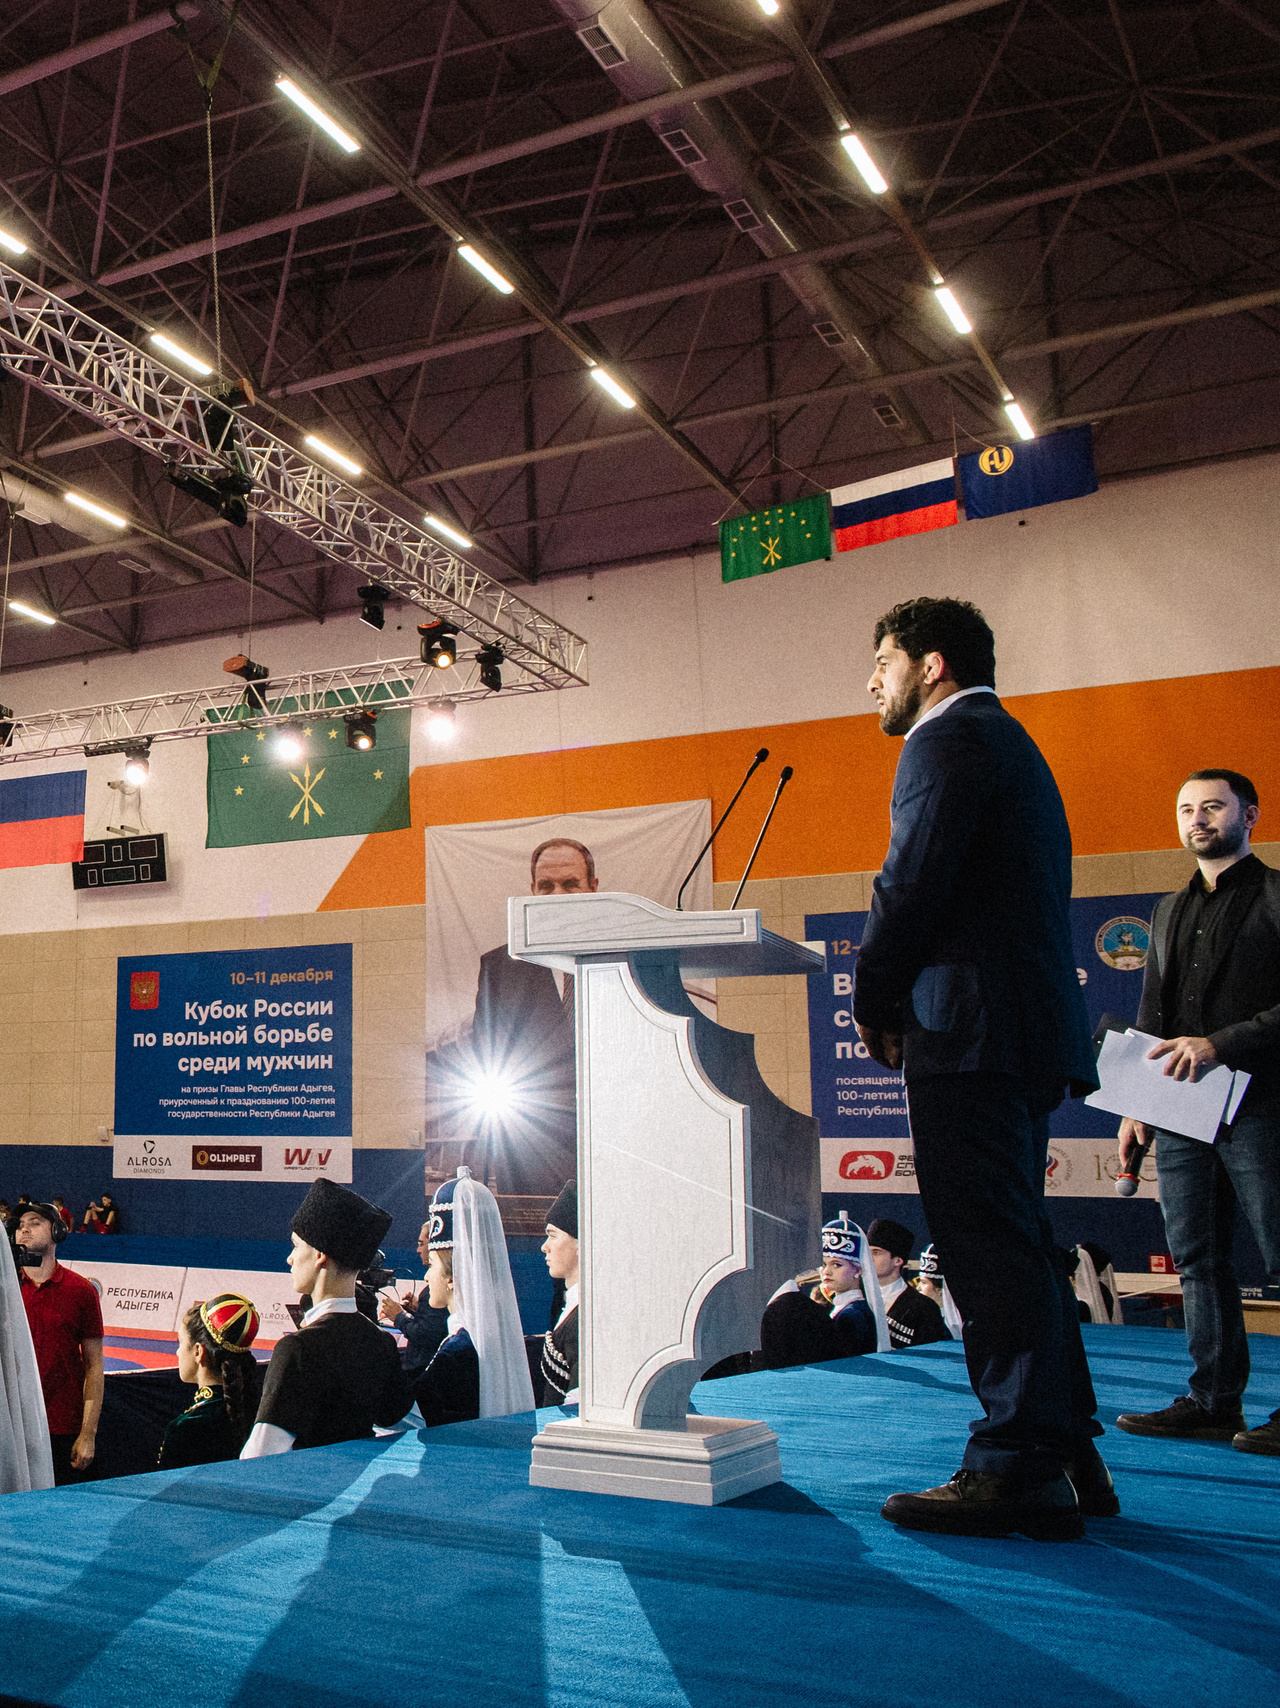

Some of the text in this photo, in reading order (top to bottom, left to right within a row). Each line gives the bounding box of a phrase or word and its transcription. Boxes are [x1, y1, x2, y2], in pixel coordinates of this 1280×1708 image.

[270, 968, 333, 986] декабря
[184, 998, 333, 1026] Кубок России
[133, 1022, 333, 1048] по вольной борьбе
[178, 1054, 333, 1077] среди мужчин
[193, 1085, 219, 1095] призы
[220, 1084, 246, 1093] Главы
[247, 1084, 298, 1095] Республики
[836, 1090, 899, 1101] 100-летия
[159, 1096, 219, 1107] приуроченный
[226, 1097, 289, 1107] празднованию
[291, 1096, 336, 1105] 100-летия
[167, 1108, 336, 1120] государственности Республики Адыгея
[127, 1156, 172, 1167] ALROSA
[209, 1153, 257, 1163] OLIMPBET
[107, 1287, 174, 1301] РЕСПУБЛИКА
[115, 1300, 159, 1312] АДЫГЕЯ
